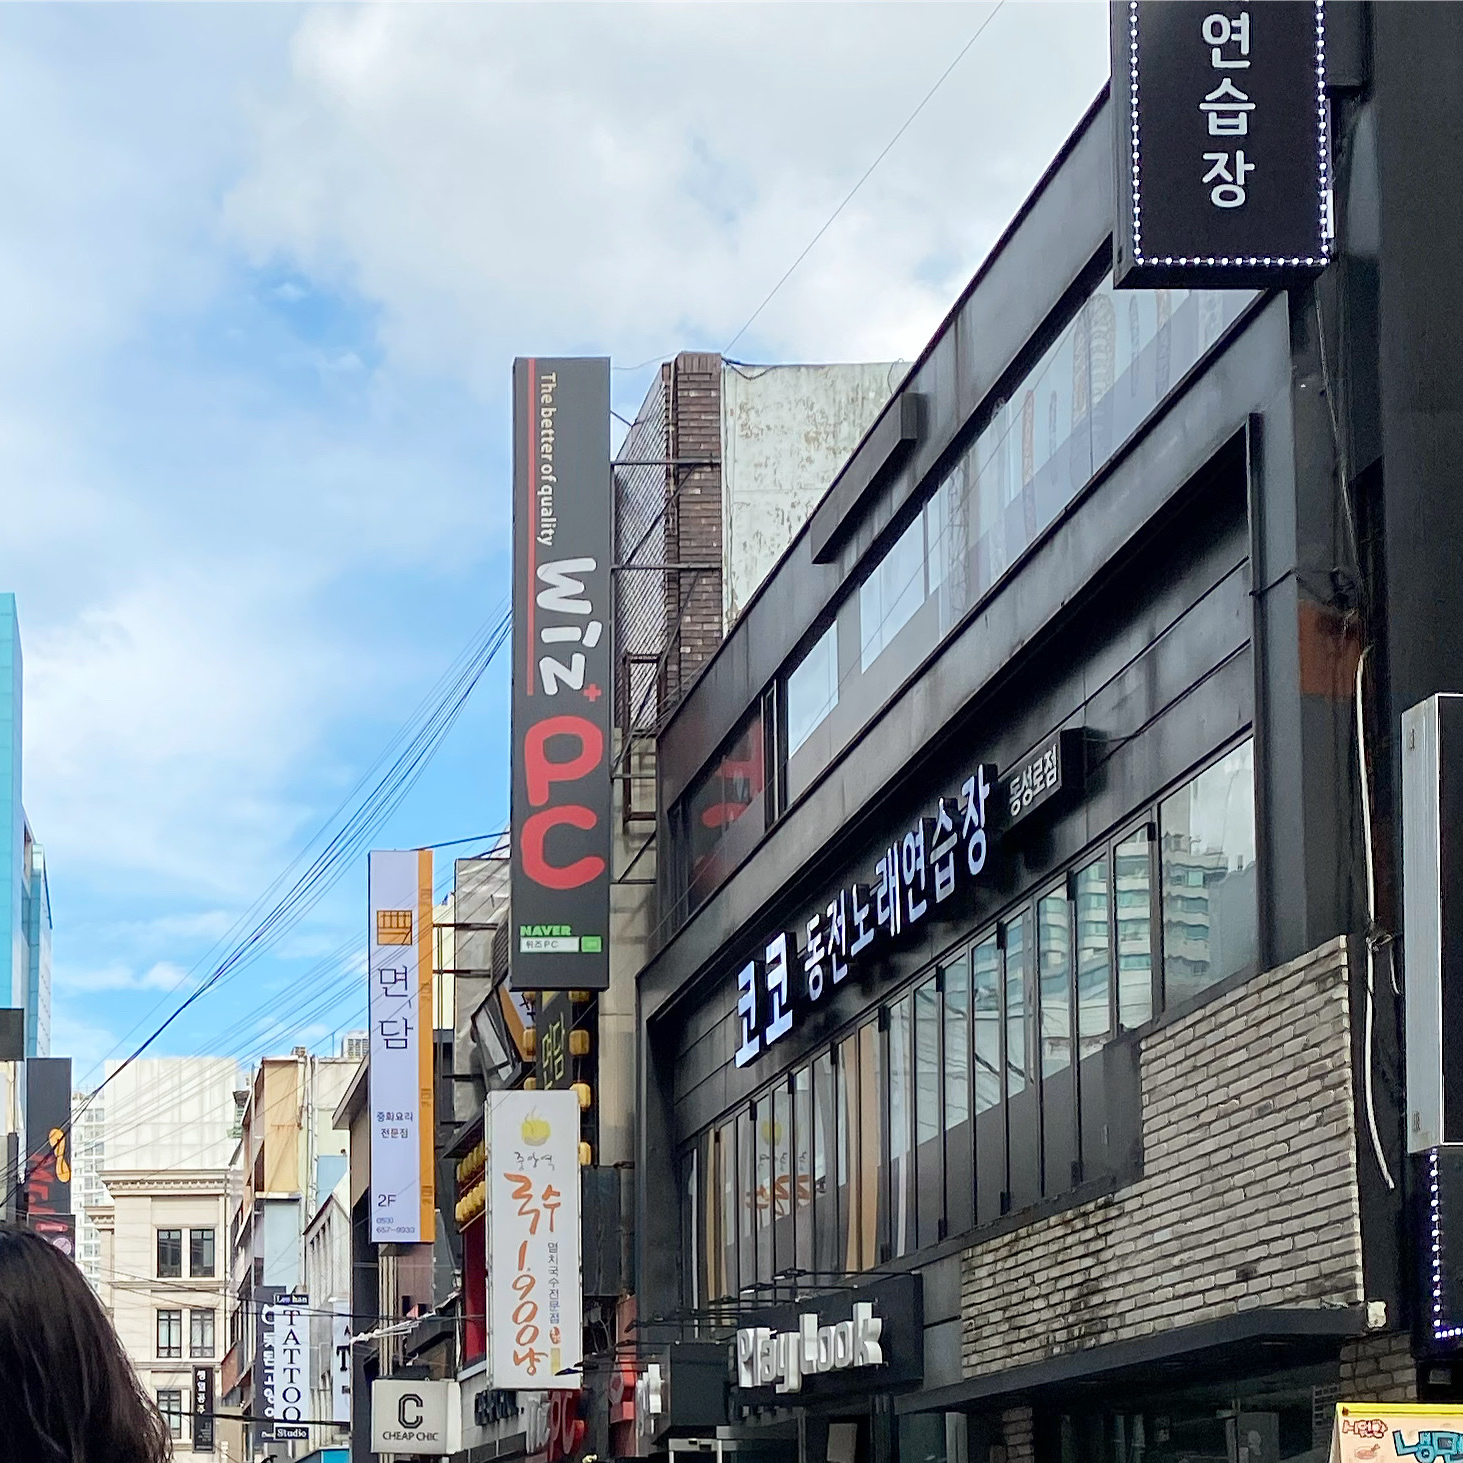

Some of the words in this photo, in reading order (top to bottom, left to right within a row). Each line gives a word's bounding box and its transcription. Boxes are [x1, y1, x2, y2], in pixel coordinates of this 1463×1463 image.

[1199, 11, 1256, 208] 연습장
[540, 372, 557, 403] The
[540, 408, 556, 462] better
[540, 464, 556, 483] of
[537, 485, 555, 547] quality
[520, 714, 605, 889] PC
[1009, 744, 1058, 817] 동성로점
[520, 925, 571, 936] NAVER
[735, 932, 793, 1069] 코코
[805, 764, 990, 1001] 동전노래연습장
[378, 1194, 397, 1208] 2F
[547, 1241, 560, 1324] 멸치국수전문점
[282, 1309, 301, 1421] TATTOO
[277, 1428, 307, 1438] Studio
[382, 1431, 416, 1441] CHEAP
[416, 1431, 438, 1441] CHIC
